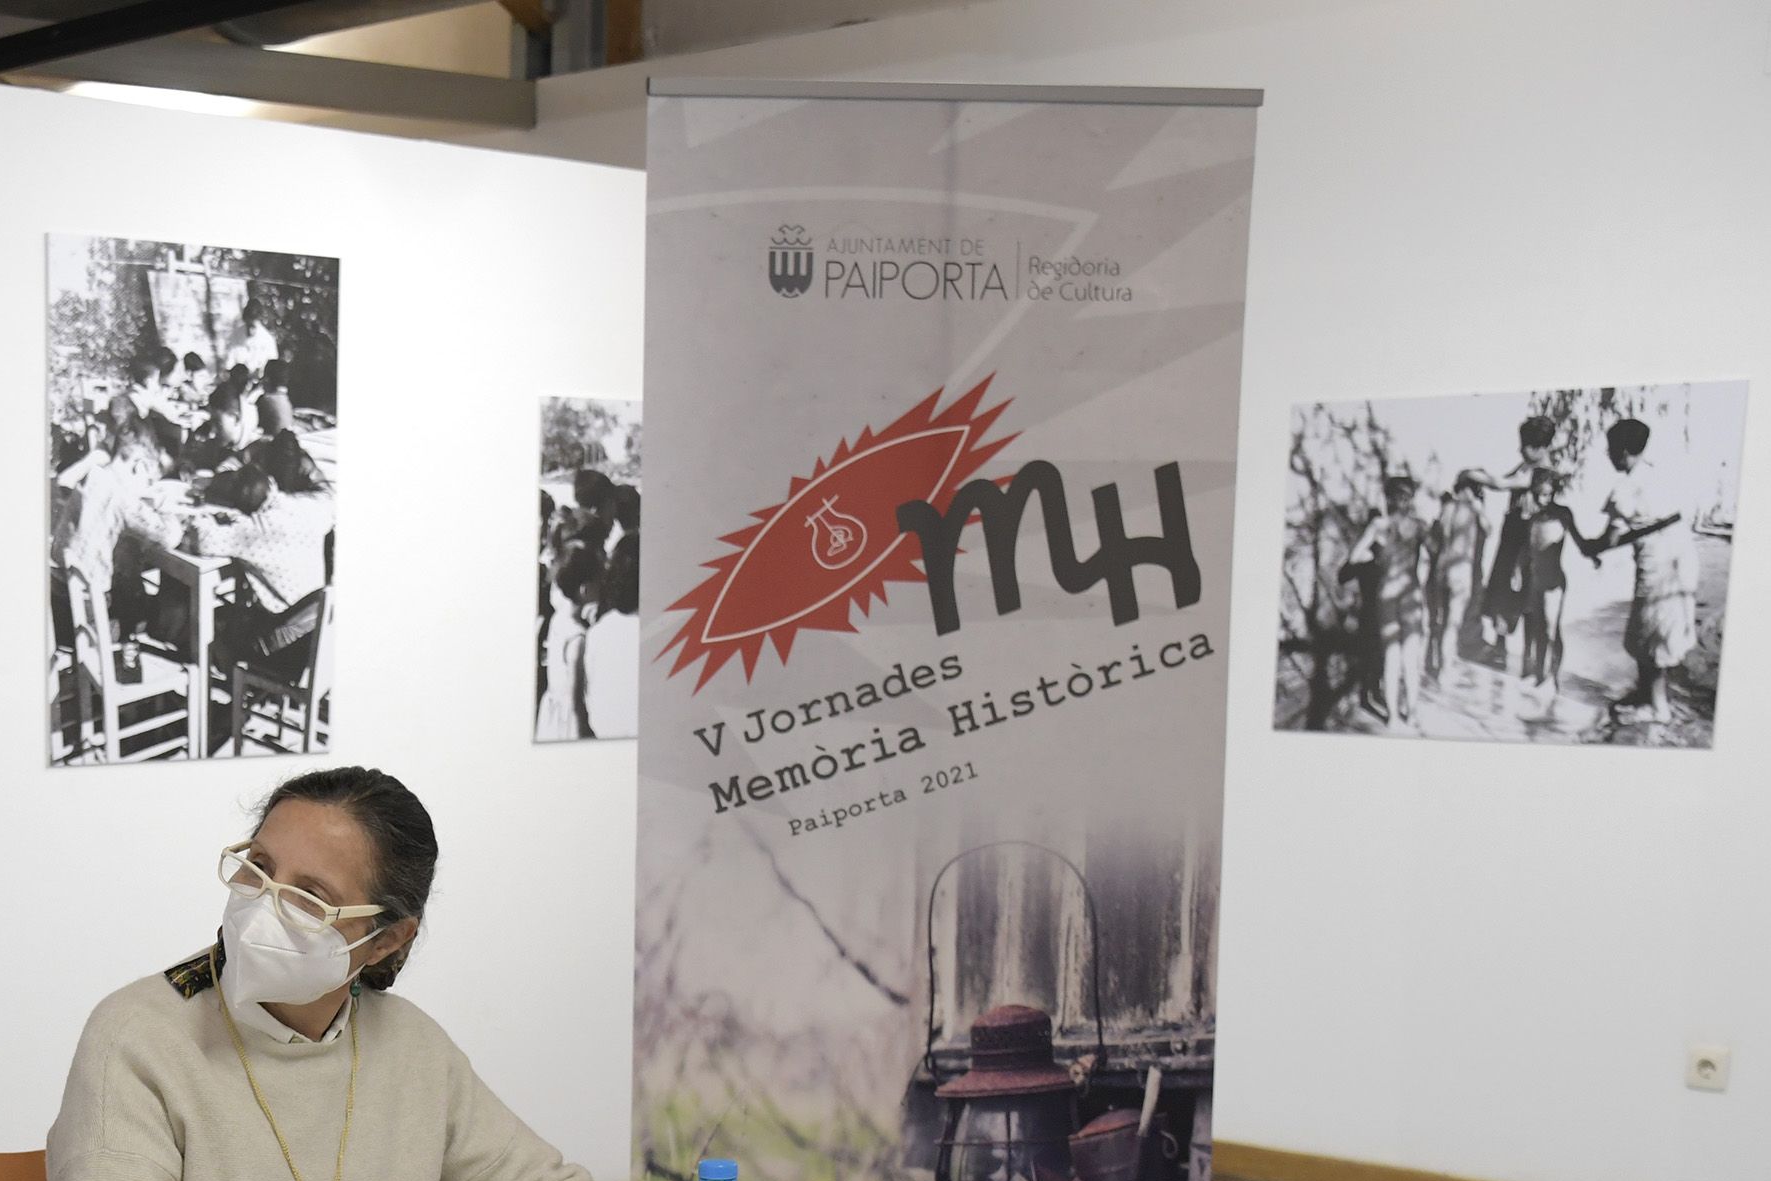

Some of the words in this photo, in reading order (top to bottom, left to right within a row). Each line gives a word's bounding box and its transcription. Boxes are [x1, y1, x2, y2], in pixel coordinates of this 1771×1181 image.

[827, 238, 952, 255] AJUNTAMENT
[960, 239, 985, 256] DE
[824, 260, 1008, 301] PAIPORTA
[1029, 256, 1120, 281] Regidoria
[1027, 281, 1054, 301] de
[1059, 281, 1133, 302] Cultura
[694, 721, 729, 757] V
[743, 654, 963, 745] Jornades
[709, 725, 926, 813] Memòria
[947, 633, 1215, 738] Històrica
[788, 788, 908, 836] Paiporta
[920, 761, 979, 794] 2021
